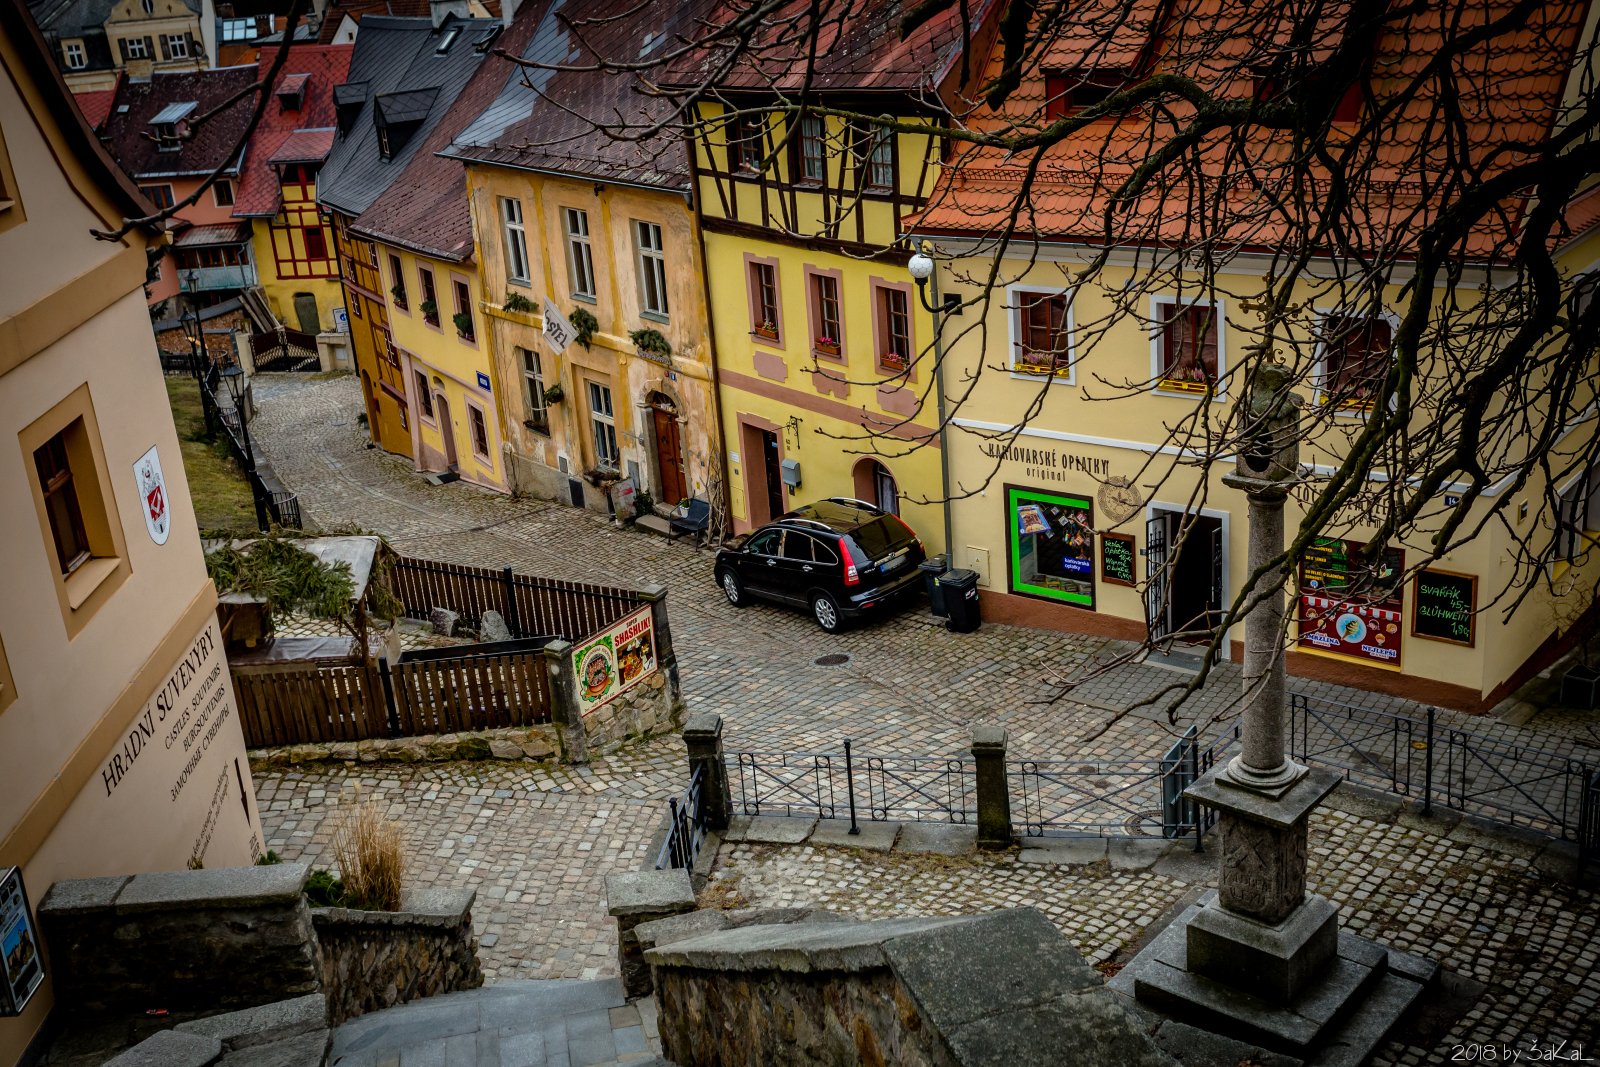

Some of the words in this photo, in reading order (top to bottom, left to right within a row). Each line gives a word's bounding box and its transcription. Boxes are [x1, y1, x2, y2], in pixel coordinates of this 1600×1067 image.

[988, 443, 1056, 468] KARLOVARSKÉ
[1061, 454, 1107, 475] OPLATKY
[1026, 467, 1066, 482] original
[1420, 584, 1461, 600] SVAŘÁK
[1450, 599, 1471, 611] 45,-
[1418, 605, 1470, 623] GLÜHWEIN
[626, 617, 638, 628] SUPER
[614, 616, 651, 647] SHASHLIK!
[1362, 645, 1396, 657] NEJLEPŠÍ
[102, 703, 154, 797] HRADNÍ
[156, 625, 215, 722] SUVENÝRY
